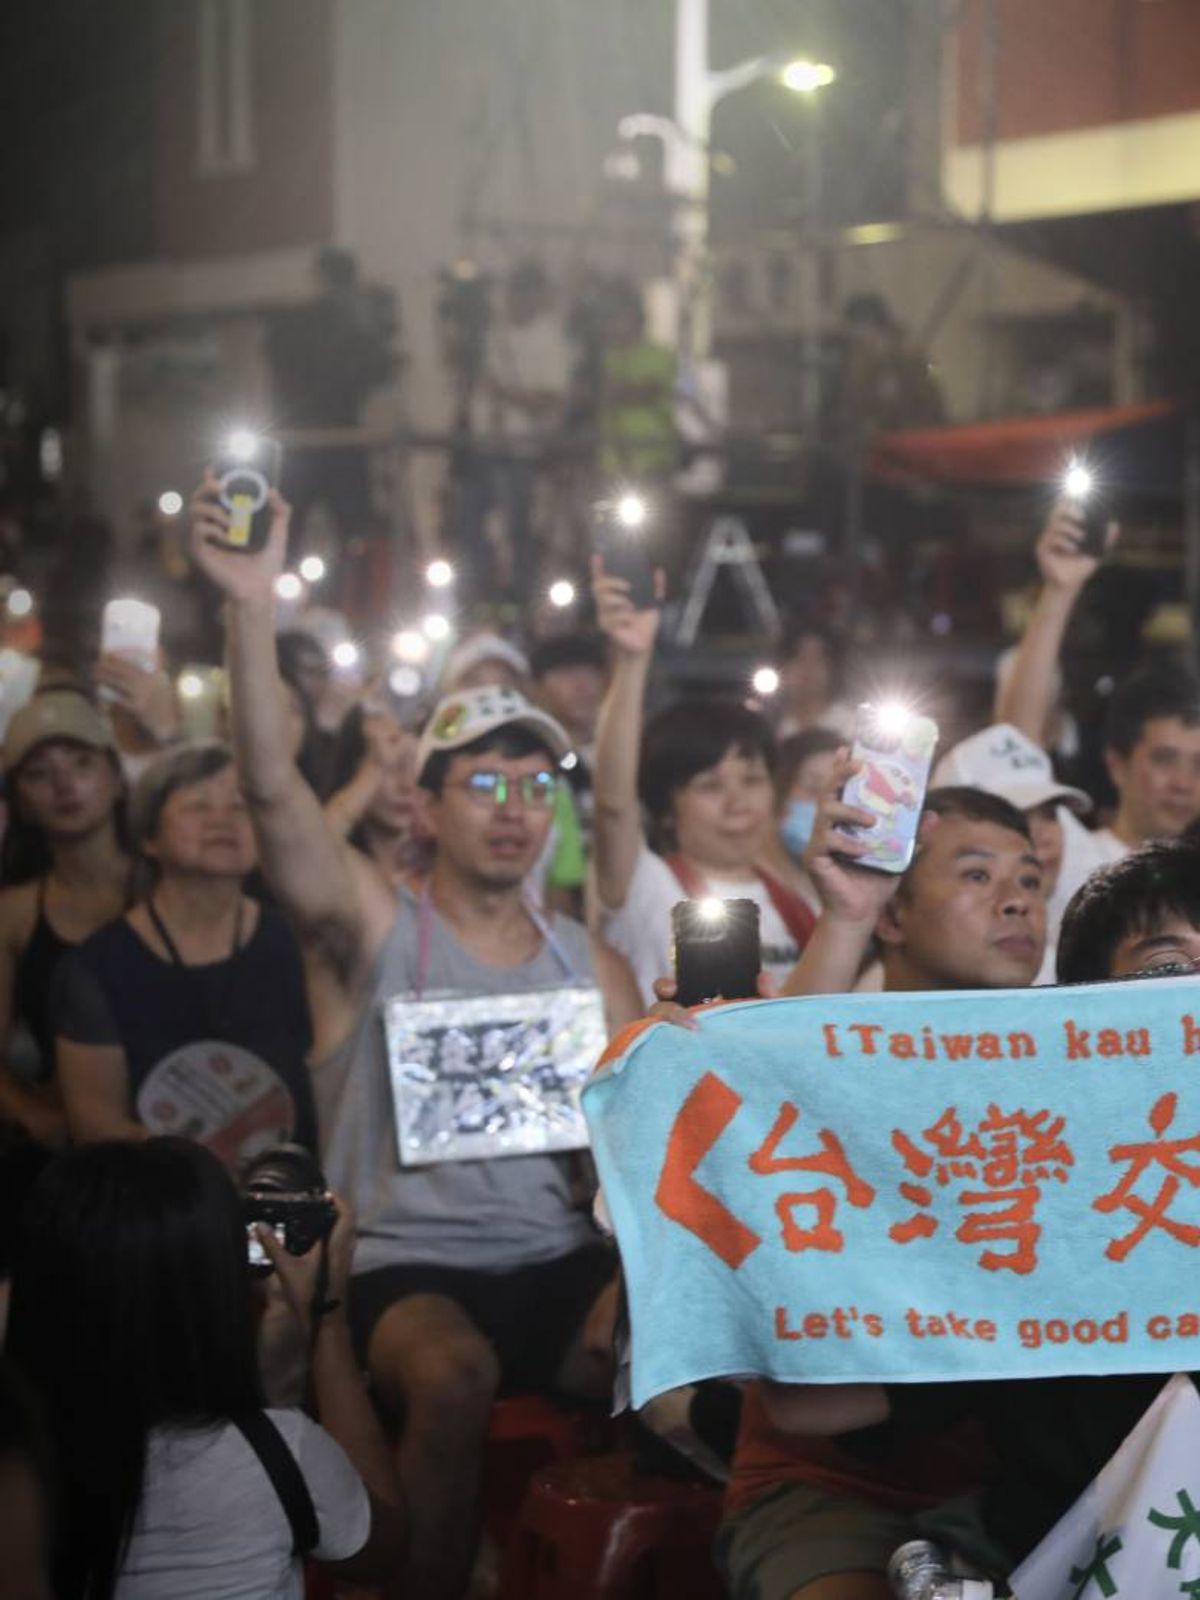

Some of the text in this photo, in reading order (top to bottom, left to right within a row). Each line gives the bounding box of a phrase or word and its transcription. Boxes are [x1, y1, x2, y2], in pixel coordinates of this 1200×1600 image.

[1065, 1020, 1151, 1059] kau
[776, 1308, 882, 1339] Let's
[907, 1310, 995, 1338] take
[1018, 1314, 1128, 1347] good
